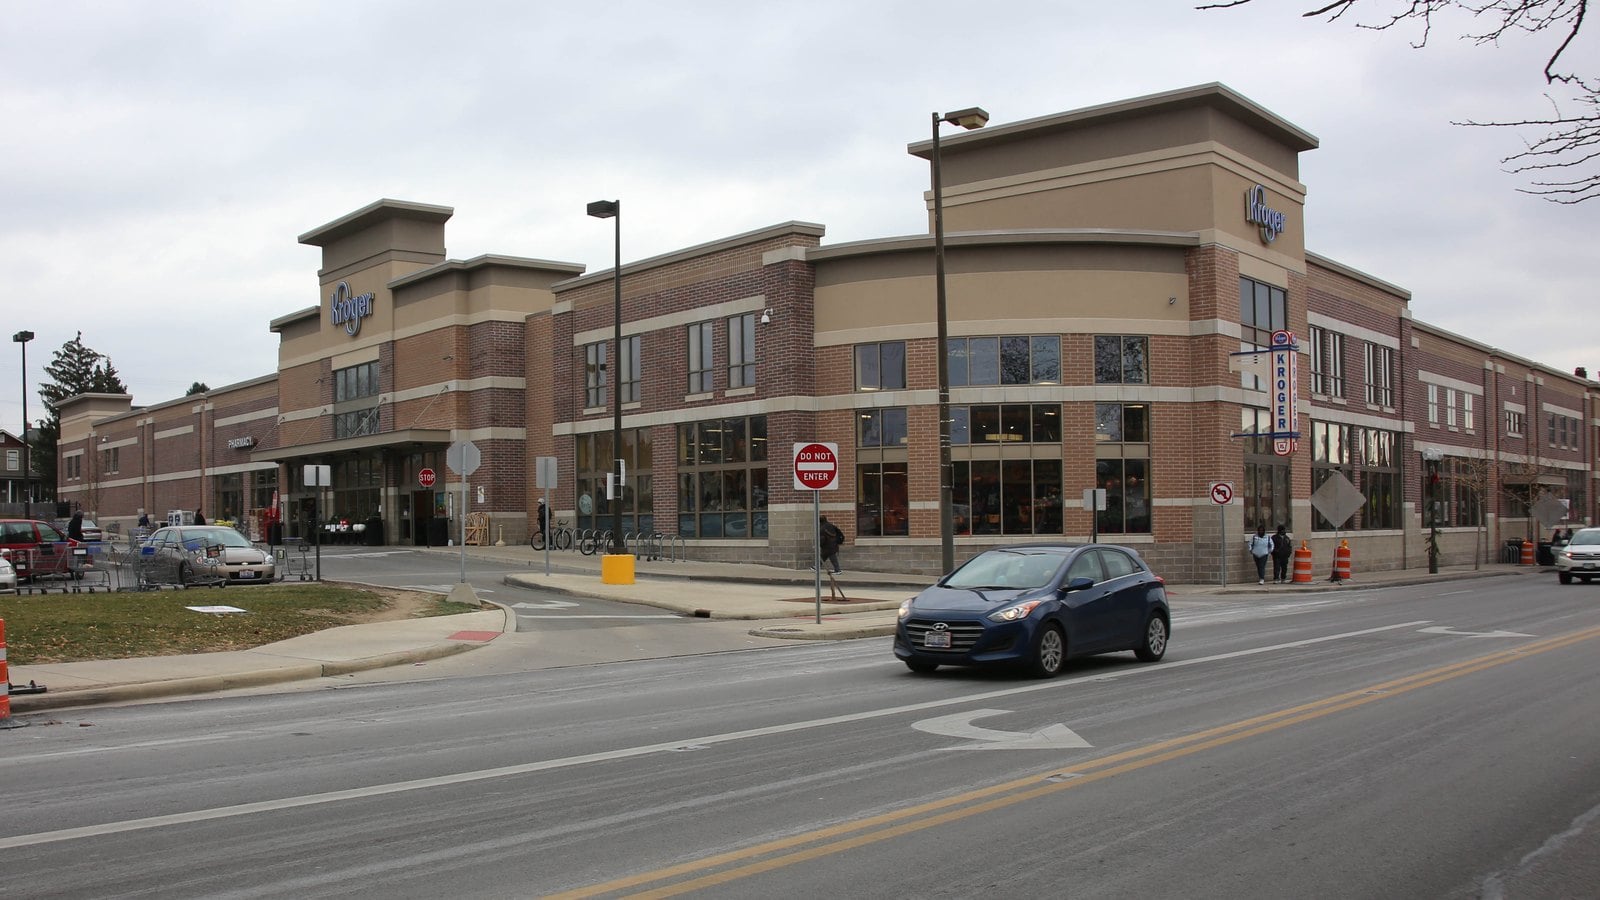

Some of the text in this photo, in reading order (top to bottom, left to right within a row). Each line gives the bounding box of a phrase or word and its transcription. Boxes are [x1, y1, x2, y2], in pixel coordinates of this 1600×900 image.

[1249, 184, 1286, 242] Kroger
[331, 280, 374, 336] Kroger
[1277, 354, 1286, 429] KROGER
[228, 436, 252, 448] PHARMACY
[800, 452, 831, 460] DO NOT
[803, 472, 829, 481] ENTER
